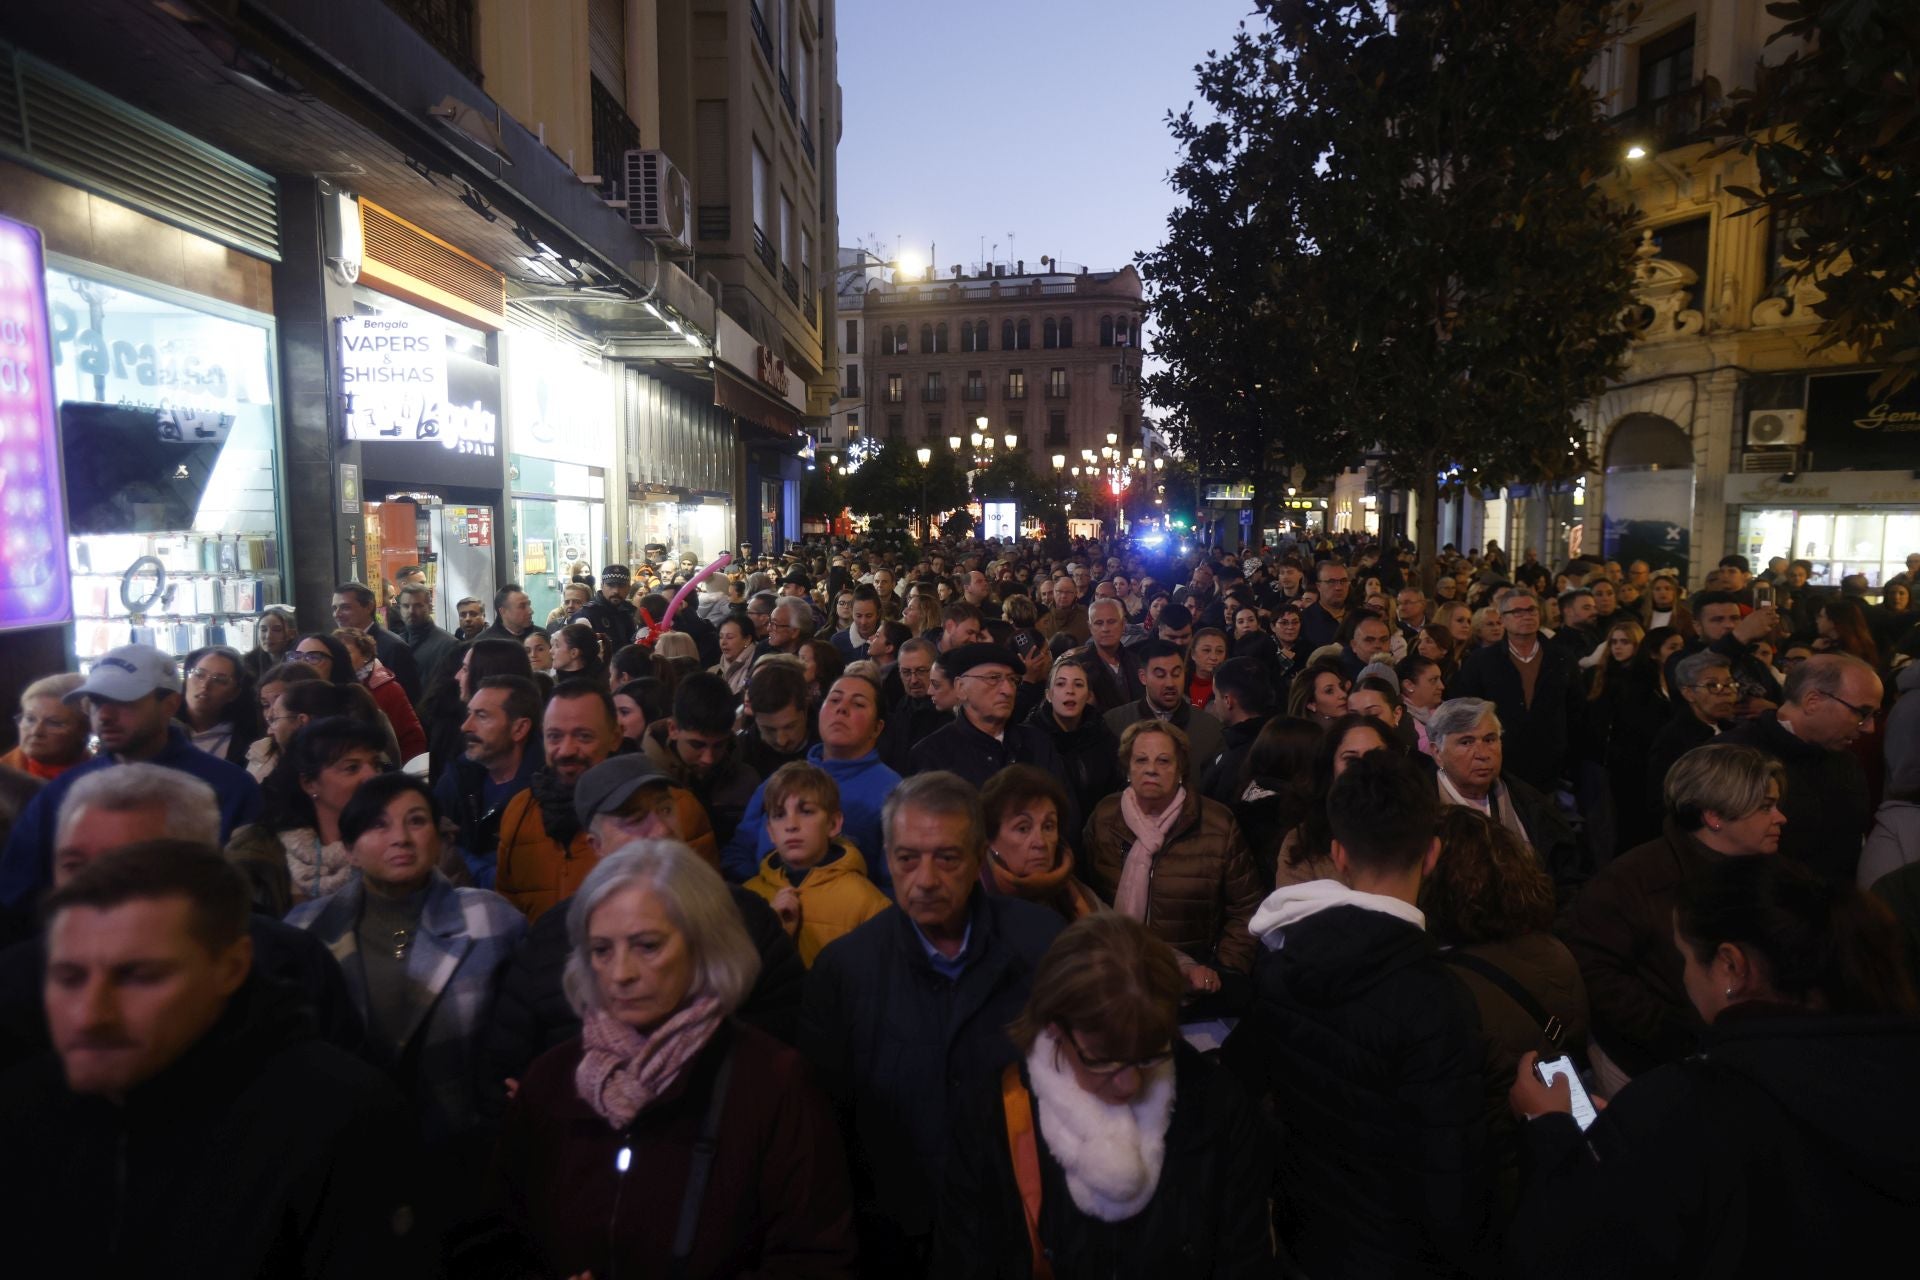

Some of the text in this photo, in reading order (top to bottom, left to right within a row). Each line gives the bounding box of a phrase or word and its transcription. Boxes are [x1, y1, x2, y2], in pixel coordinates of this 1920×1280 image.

[363, 319, 409, 331] Bengala
[343, 335, 430, 352] VAPERS
[383, 353, 393, 365] &
[342, 366, 434, 383] SHISHAS
[458, 439, 495, 457] SPAIN
